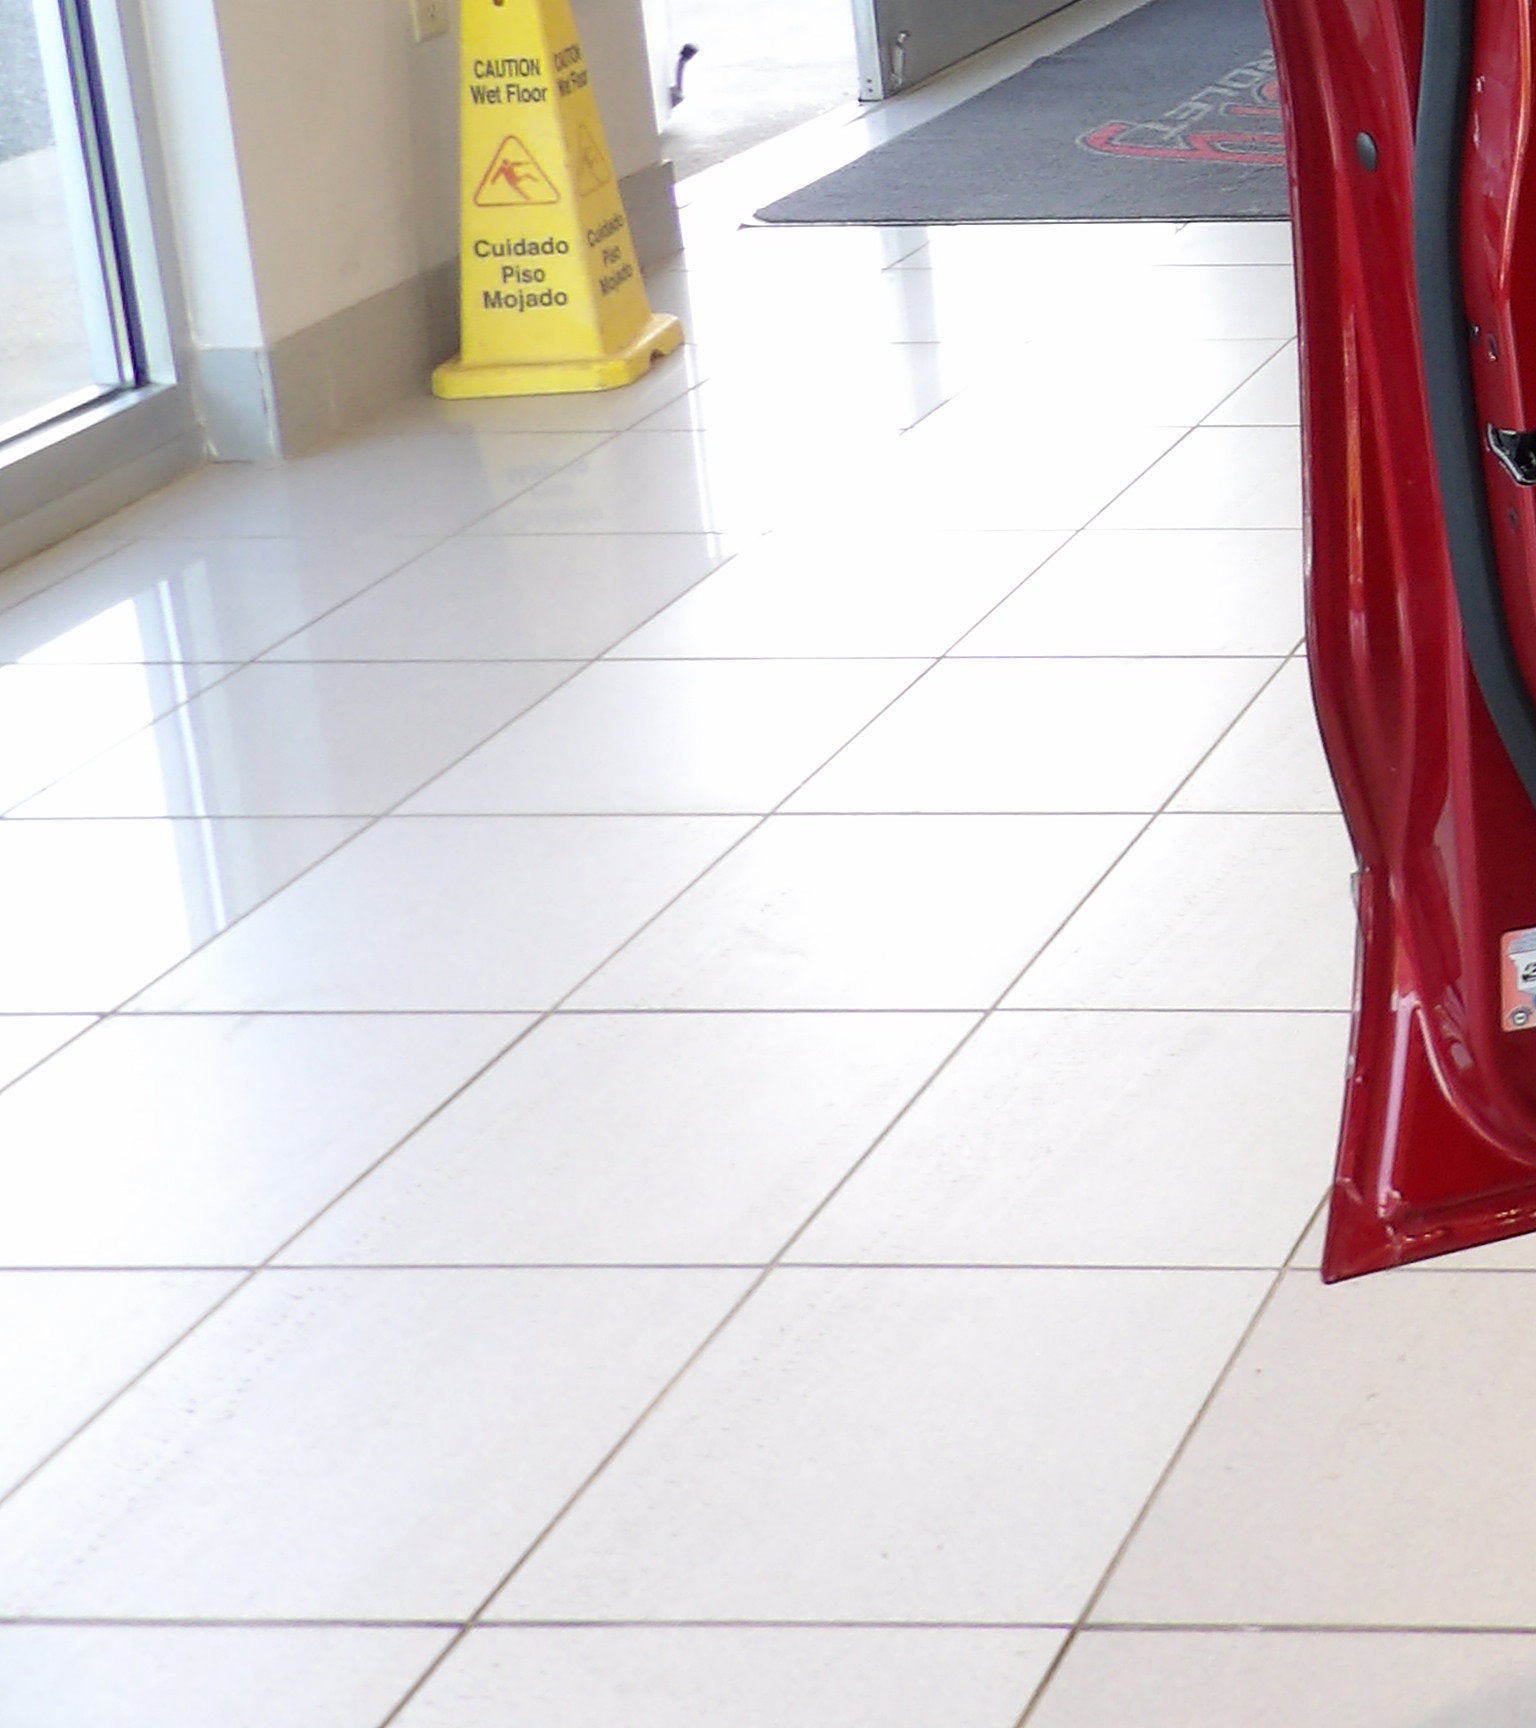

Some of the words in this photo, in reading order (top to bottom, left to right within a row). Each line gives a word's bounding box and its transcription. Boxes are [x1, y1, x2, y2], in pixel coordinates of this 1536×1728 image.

[473, 57, 541, 79] CAUTION
[469, 84, 502, 105] Wet
[506, 82, 548, 103] Floor
[473, 237, 569, 258] Cuidado
[501, 265, 546, 284] Piso
[482, 289, 568, 313] Mojado
